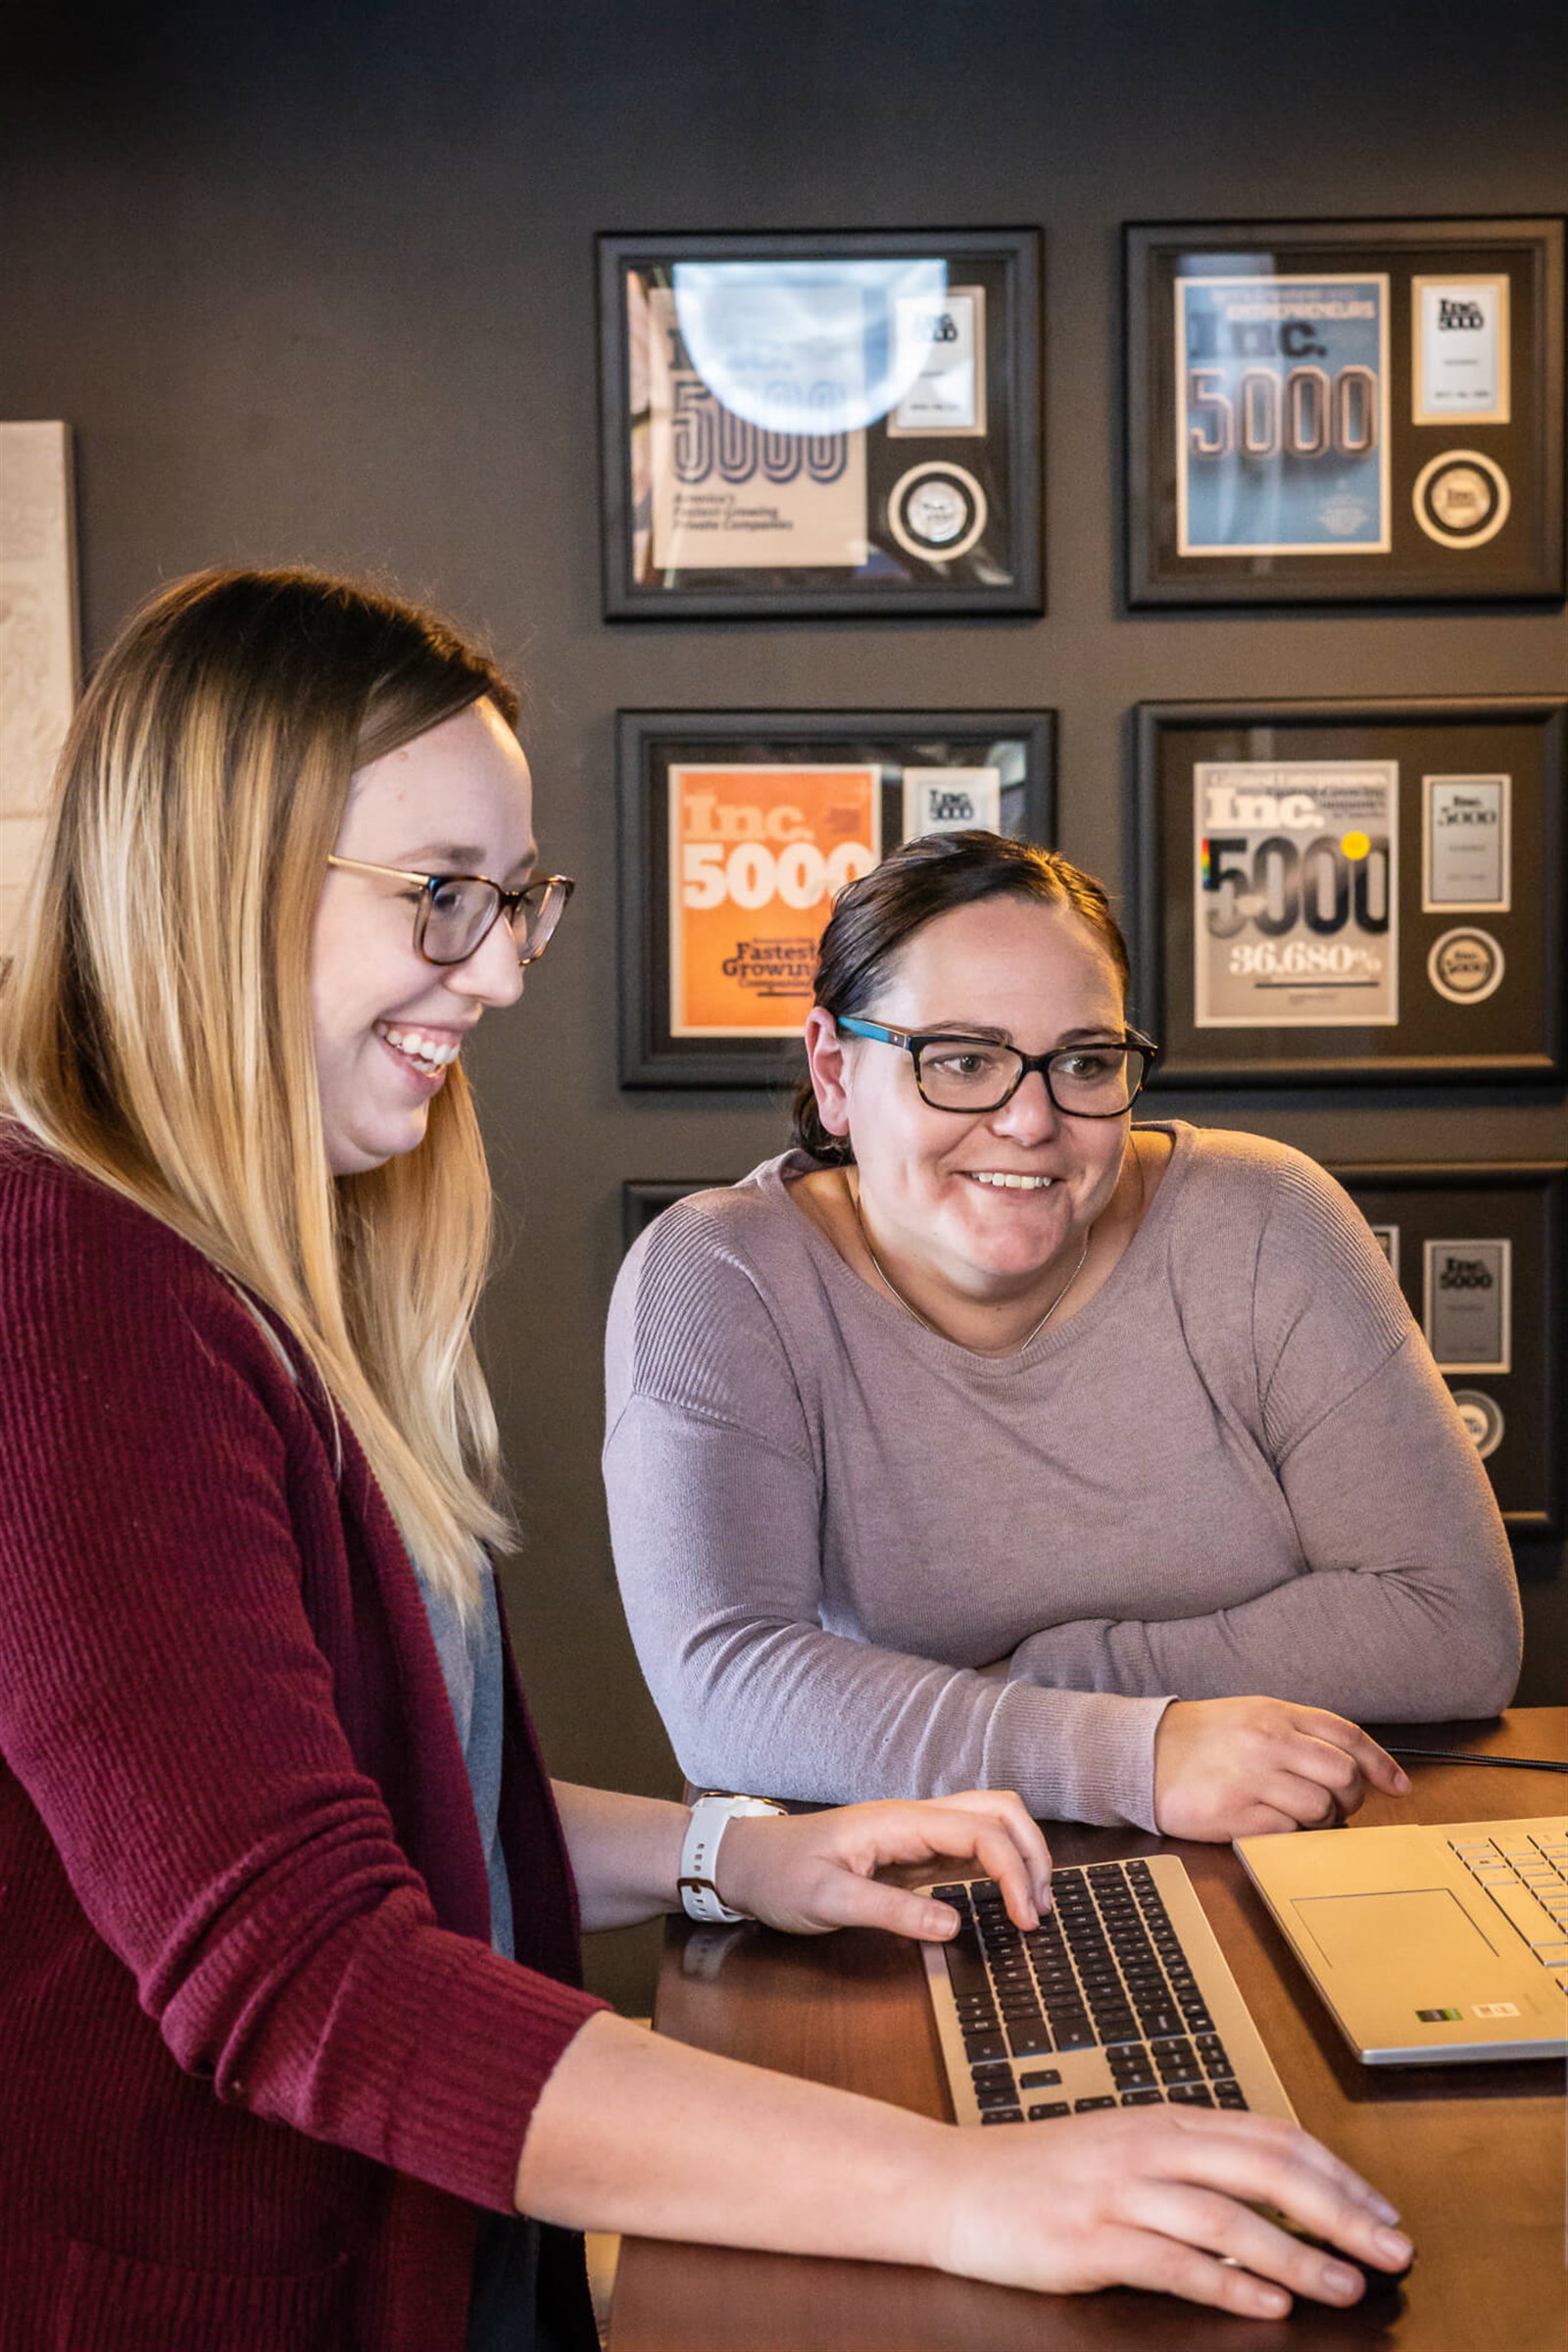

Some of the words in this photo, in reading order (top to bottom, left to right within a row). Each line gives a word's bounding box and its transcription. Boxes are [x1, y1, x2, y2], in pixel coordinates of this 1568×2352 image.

[1439, 313, 1485, 330] 5000
[1189, 364, 1379, 459] 5000
[684, 789, 816, 843] Inc.
[929, 803, 973, 820] 5000
[1205, 787, 1325, 829] Inc.
[1201, 836, 1390, 939] 5000
[736, 941, 816, 960] Fastest
[1440, 1271, 1493, 1291] 5000
